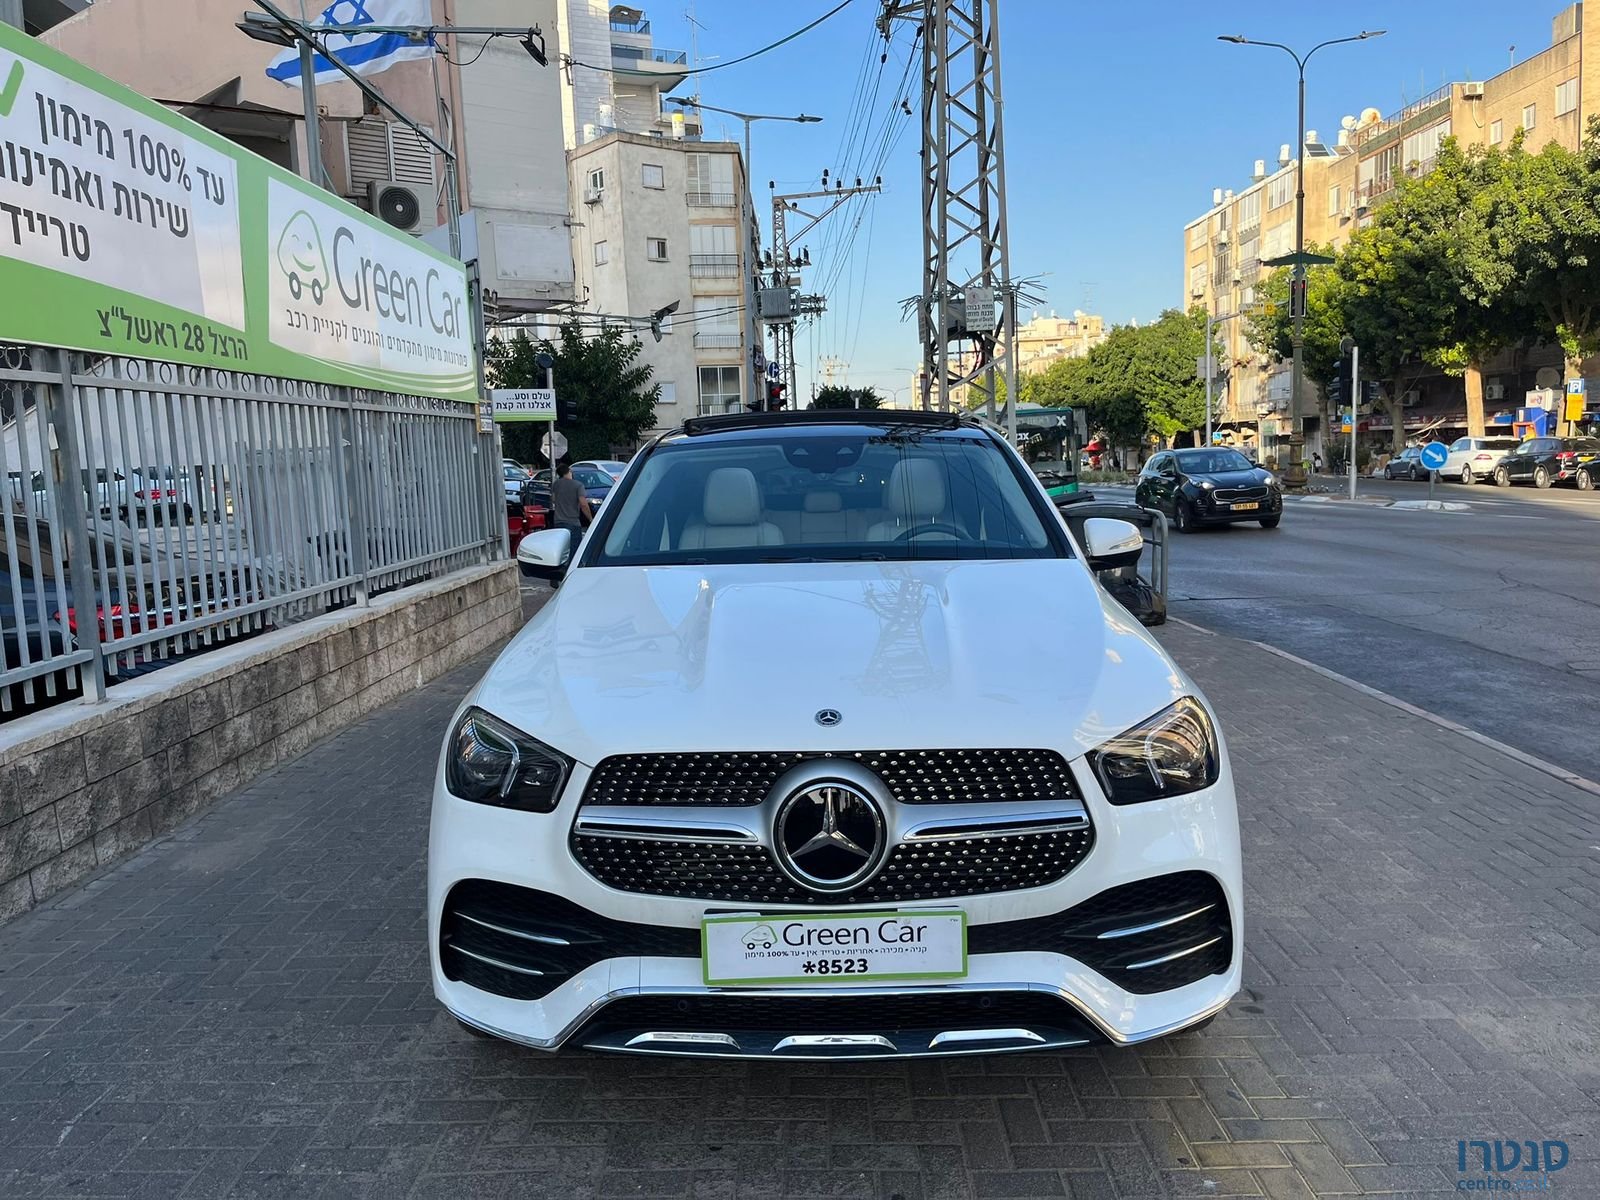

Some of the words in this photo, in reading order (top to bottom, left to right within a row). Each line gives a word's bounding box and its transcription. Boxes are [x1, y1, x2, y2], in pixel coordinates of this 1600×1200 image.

[35, 92, 114, 160] מימון
[123, 129, 191, 192] 100%
[0, 140, 104, 211] ואמינו
[196, 166, 225, 205] עד
[112, 181, 189, 238] שירות
[0, 202, 90, 262] טרייד
[333, 226, 423, 328] Green
[426, 268, 461, 339] Car
[286, 309, 309, 331] רכב
[313, 316, 348, 343] לקניית
[182, 322, 205, 353] 28
[208, 326, 248, 361] הרצל
[352, 326, 385, 349] והוגנים
[387, 335, 423, 358] מתקדמים
[424, 345, 442, 362] מימון
[496, 401, 514, 411] קצת
[528, 401, 551, 409] אצלנו
[532, 391, 551, 400] שלם
[783, 922, 869, 946] Green
[878, 920, 928, 943] Car
[744, 951, 765, 959] מימון
[806, 949, 817, 957] אין
[910, 946, 927, 954] קניה
